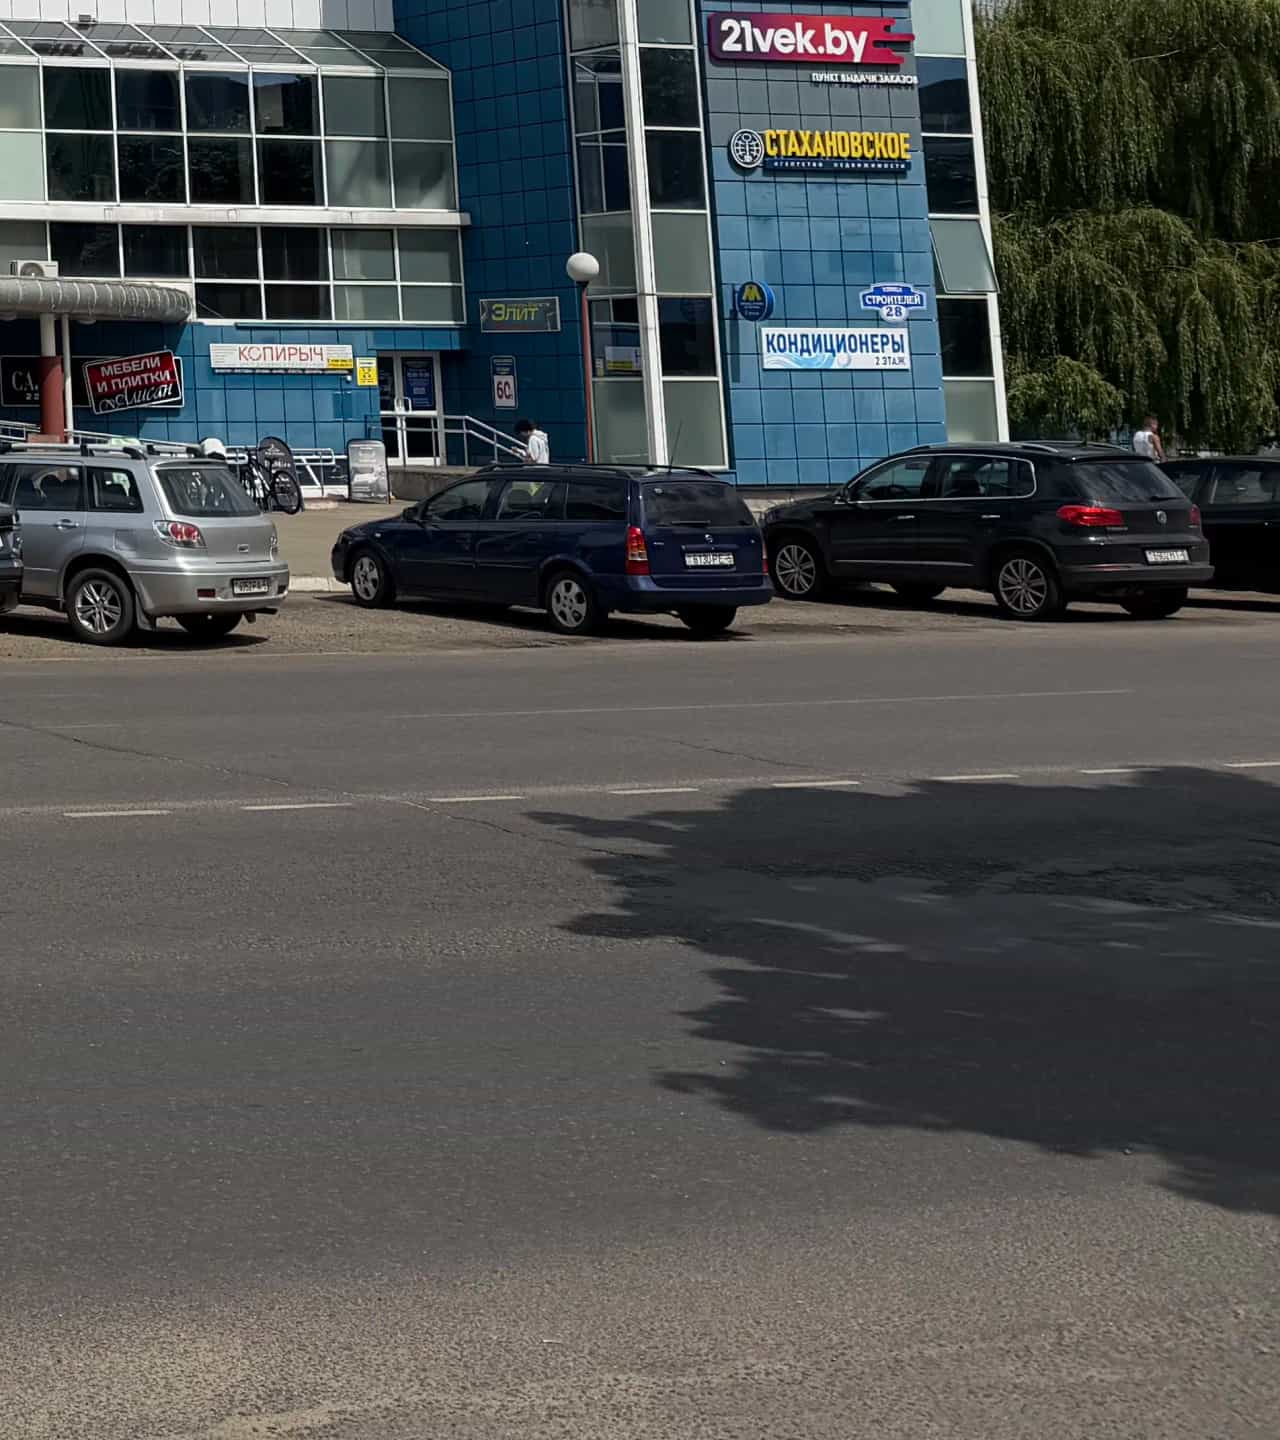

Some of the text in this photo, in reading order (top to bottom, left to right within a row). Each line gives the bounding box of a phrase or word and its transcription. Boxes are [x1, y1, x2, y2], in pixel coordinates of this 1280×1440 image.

[720, 19, 868, 62] 21vek.by
[811, 72, 840, 82] ПУНКТ
[764, 129, 911, 159] СТАХАНОВСКОЕ
[865, 294, 921, 304] СТРОИТЕЛЕЙ
[886, 307, 903, 317] 28
[239, 346, 324, 362] КОПИРЫЧ
[765, 333, 904, 356] КОНДИЦИОНЕРЫ
[100, 356, 160, 378] МЕБЕЛИ
[96, 370, 171, 393] И ПЛИТКИ
